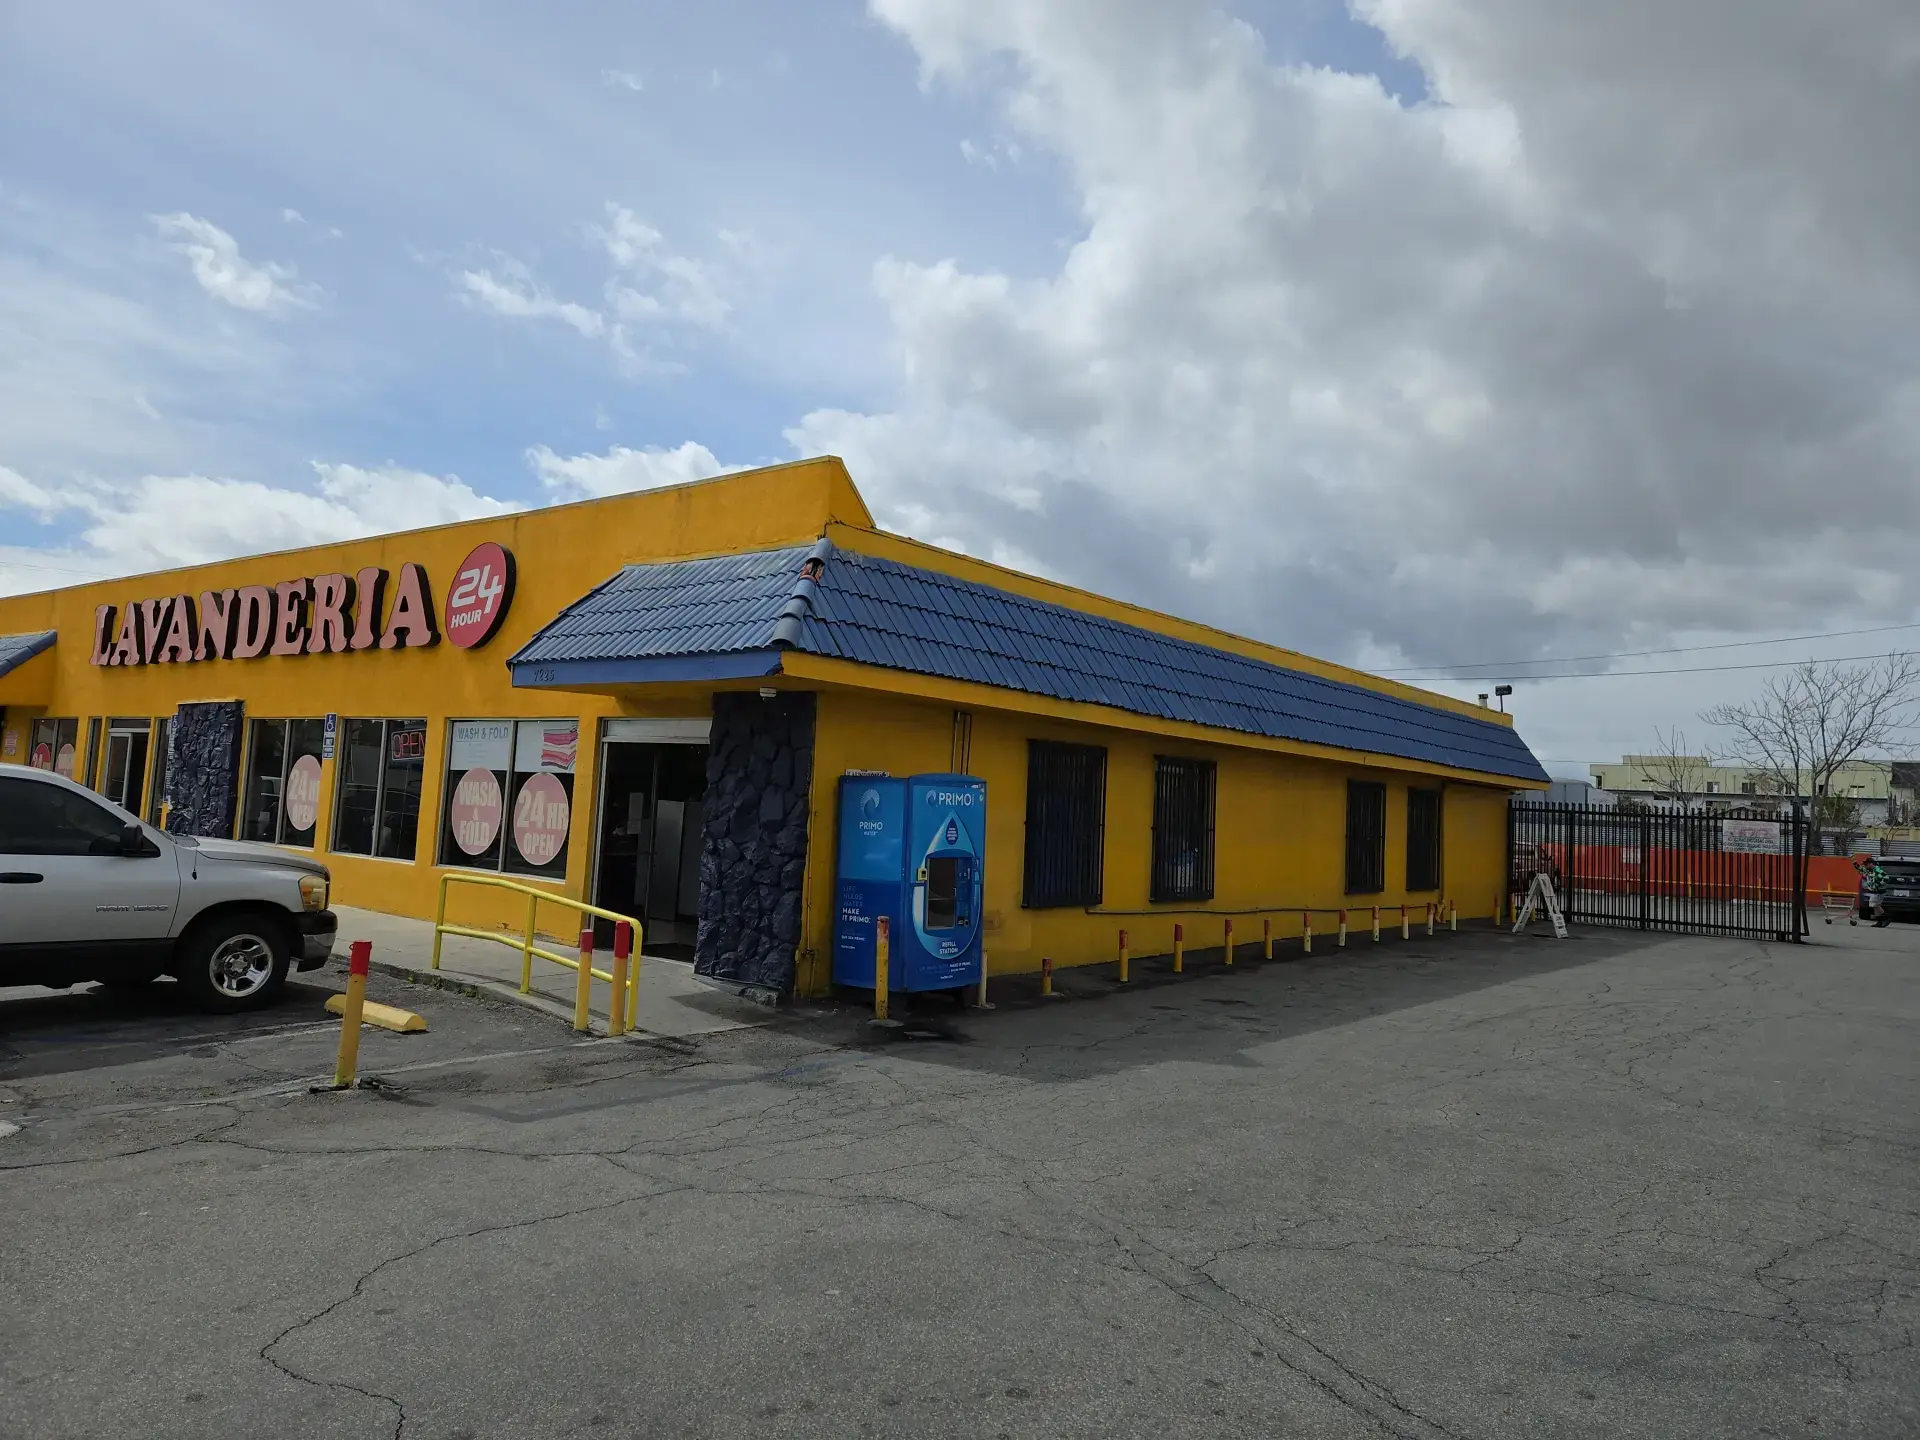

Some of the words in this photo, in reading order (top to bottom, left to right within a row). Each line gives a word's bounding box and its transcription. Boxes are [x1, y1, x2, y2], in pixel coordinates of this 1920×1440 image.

[451, 568, 502, 614] 24
[89, 562, 436, 667] LAVANDERIA
[450, 608, 482, 628] HOUR
[457, 727, 480, 740] WASH
[481, 727, 487, 739] &
[489, 726, 509, 739] FOLD
[458, 781, 499, 807] WASH
[939, 793, 972, 807] PRIMO
[516, 790, 545, 829] 24
[546, 802, 568, 831] HR
[459, 820, 490, 847] FOLD
[859, 821, 884, 831] PRIMO
[523, 833, 555, 856] OPEN
[842, 907, 860, 915] MAKE
